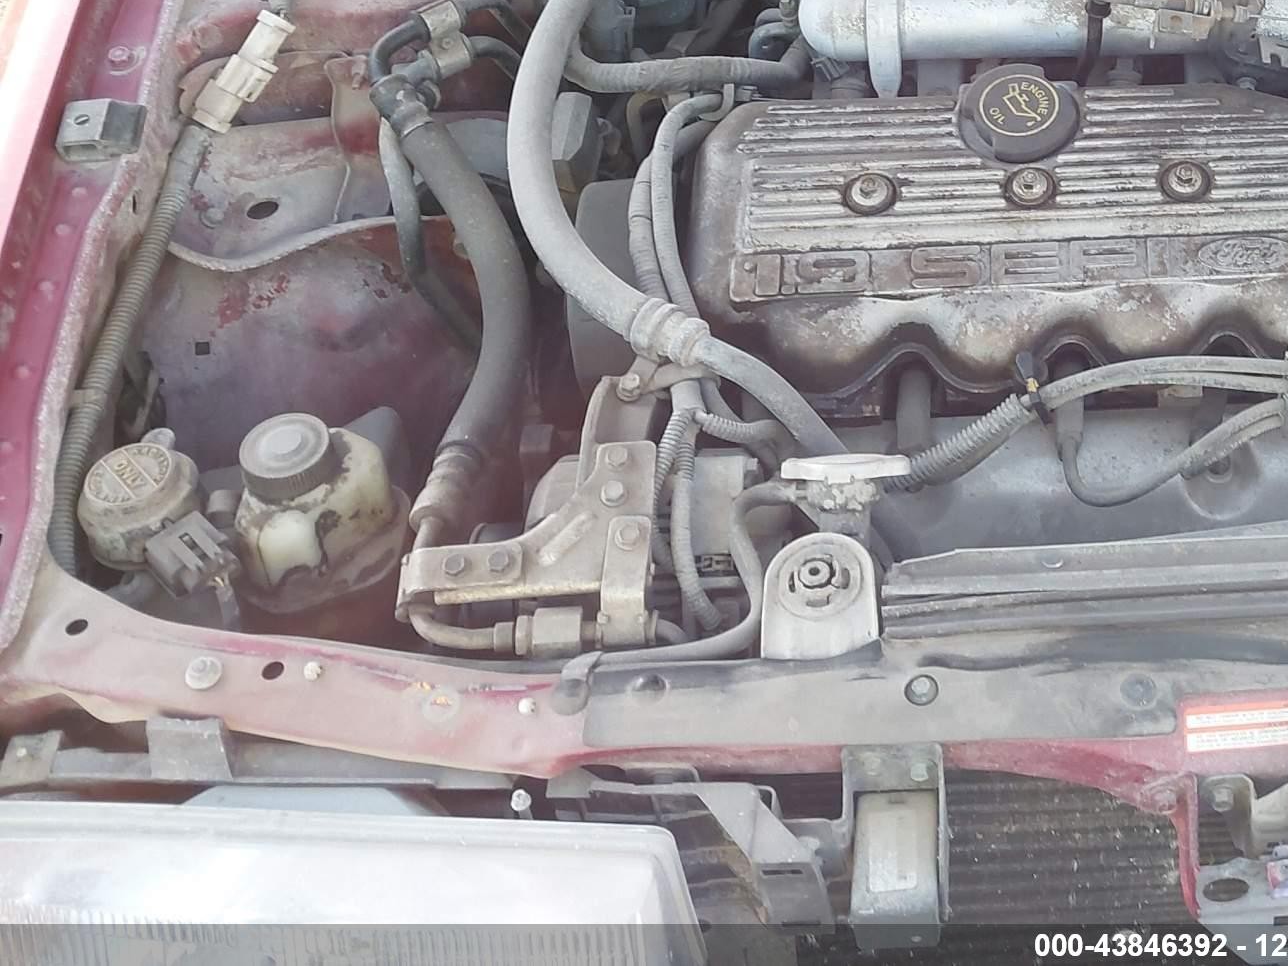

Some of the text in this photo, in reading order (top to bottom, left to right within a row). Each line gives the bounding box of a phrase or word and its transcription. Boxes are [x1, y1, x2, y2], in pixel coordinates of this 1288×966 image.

[989, 81, 1049, 125] ENGINE OIL
[741, 237, 1169, 296] 1.9 SEFI
